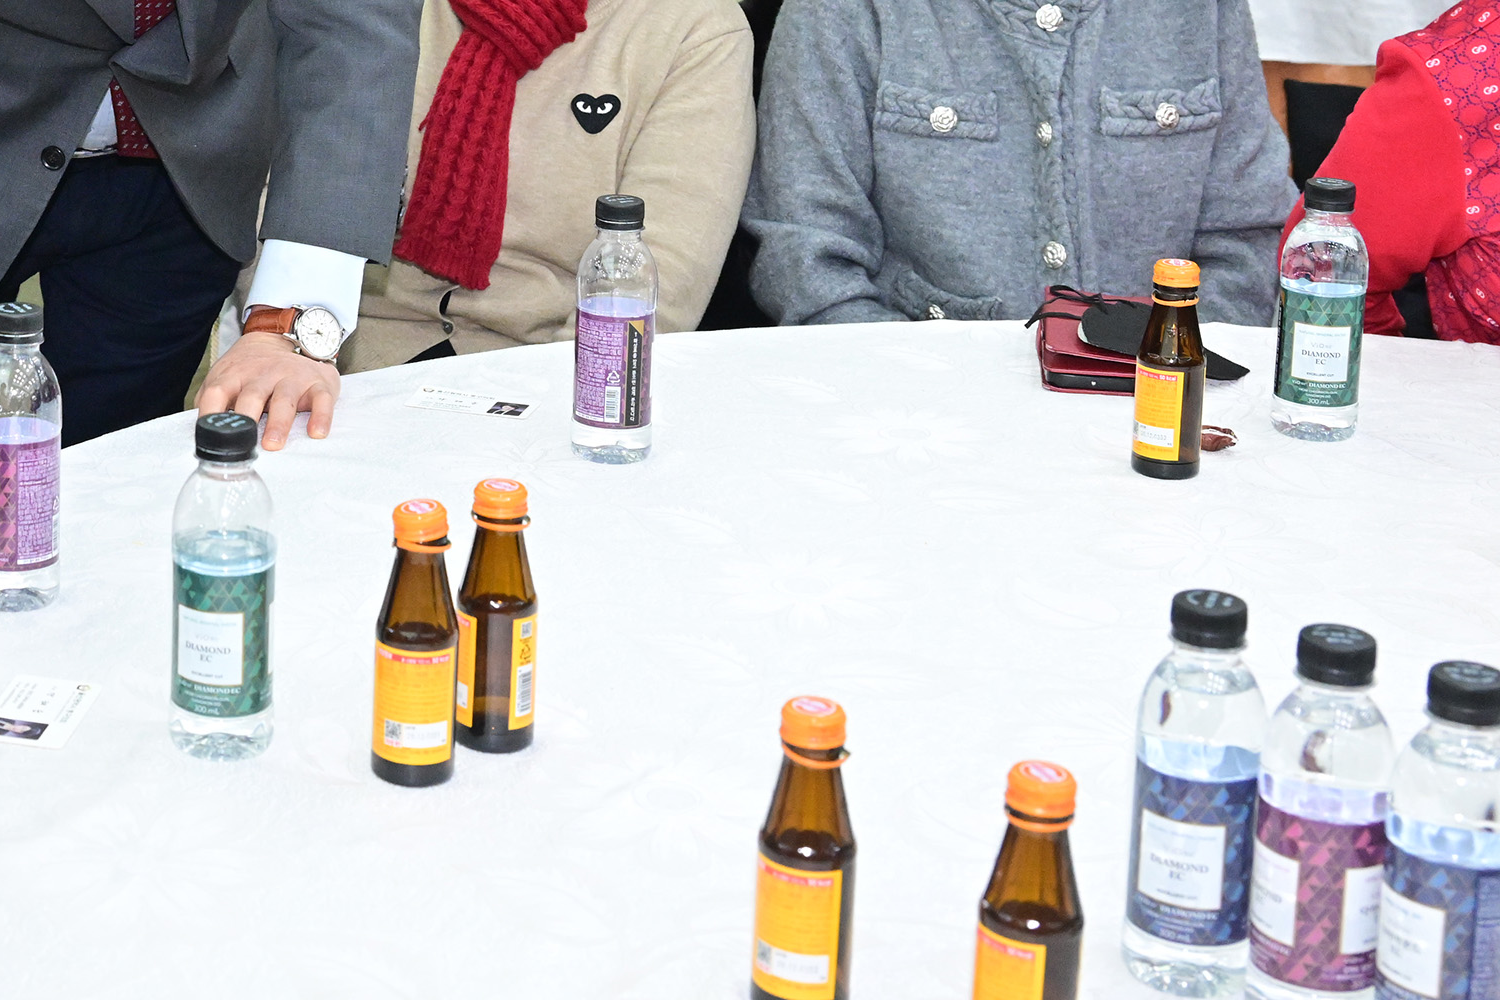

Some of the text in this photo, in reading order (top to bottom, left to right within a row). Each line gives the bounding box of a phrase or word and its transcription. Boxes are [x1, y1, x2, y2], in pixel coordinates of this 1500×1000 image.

[1302, 350, 1341, 358] DIAMOND
[186, 641, 231, 654] DIAMOND
[194, 685, 230, 694] DIAMOND
[1150, 852, 1210, 874] DIAMOND
